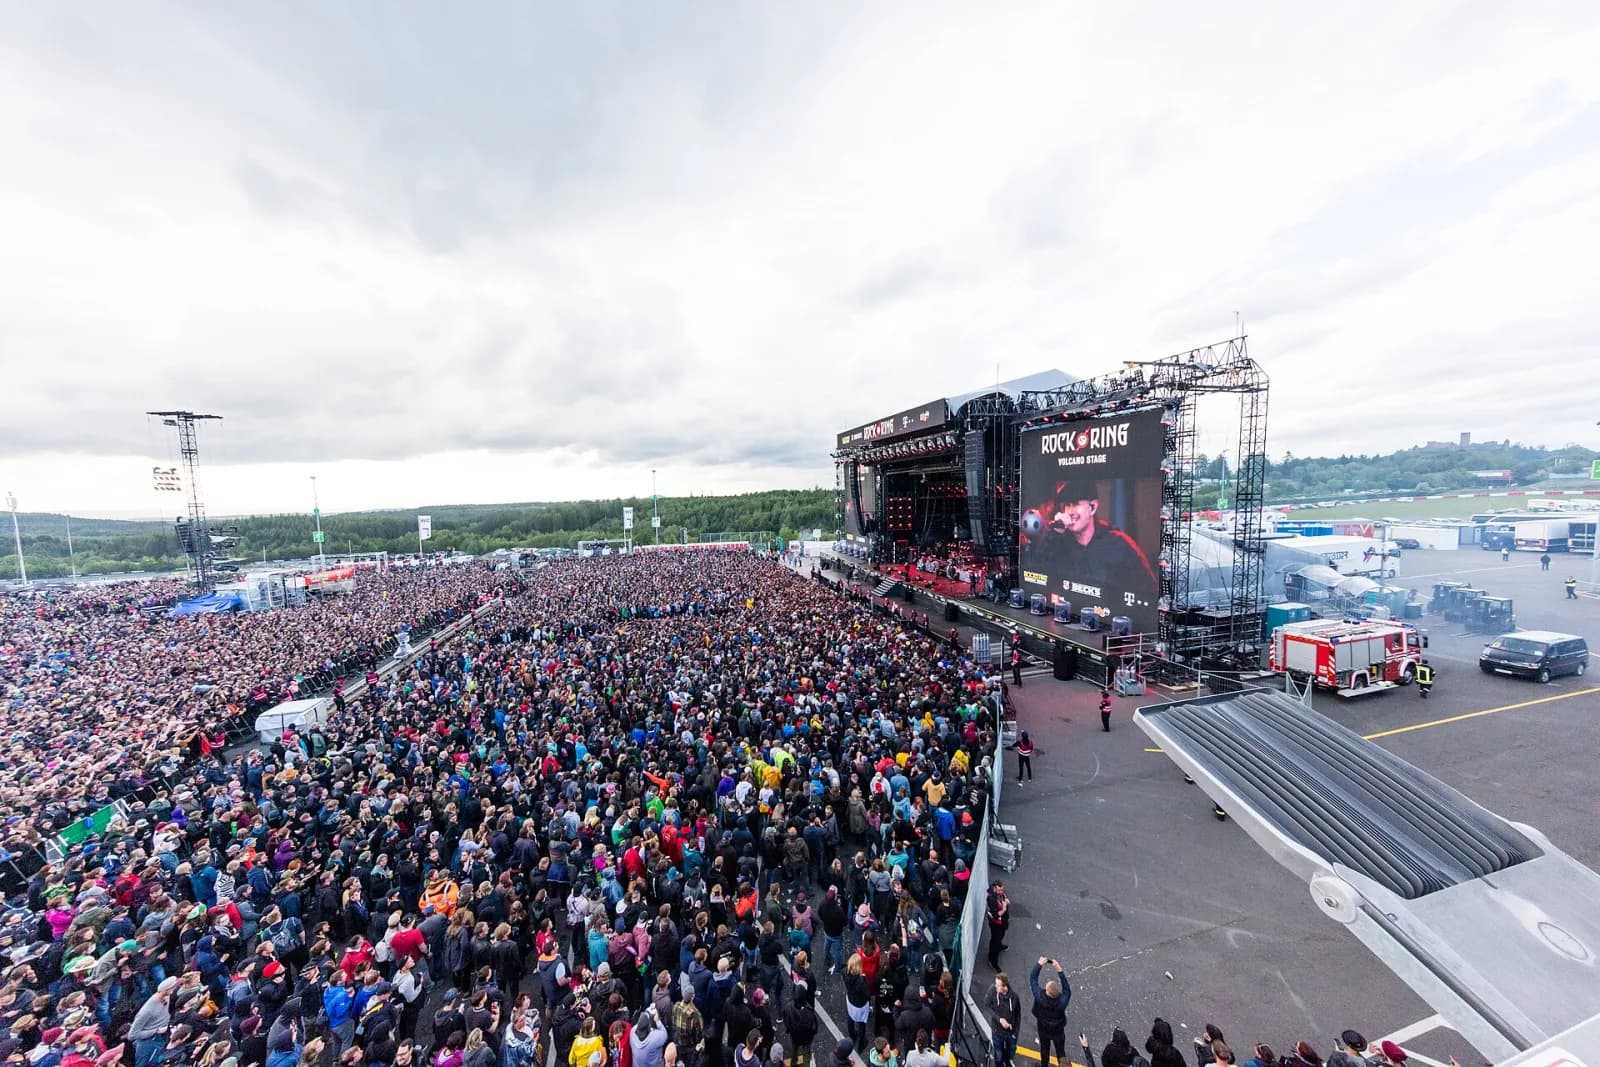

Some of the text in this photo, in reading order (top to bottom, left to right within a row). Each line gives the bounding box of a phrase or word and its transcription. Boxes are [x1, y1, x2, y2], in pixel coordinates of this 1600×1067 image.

[1041, 423, 1130, 455] ROCK RING
[1058, 454, 1107, 466] VOLCANO STAGE
